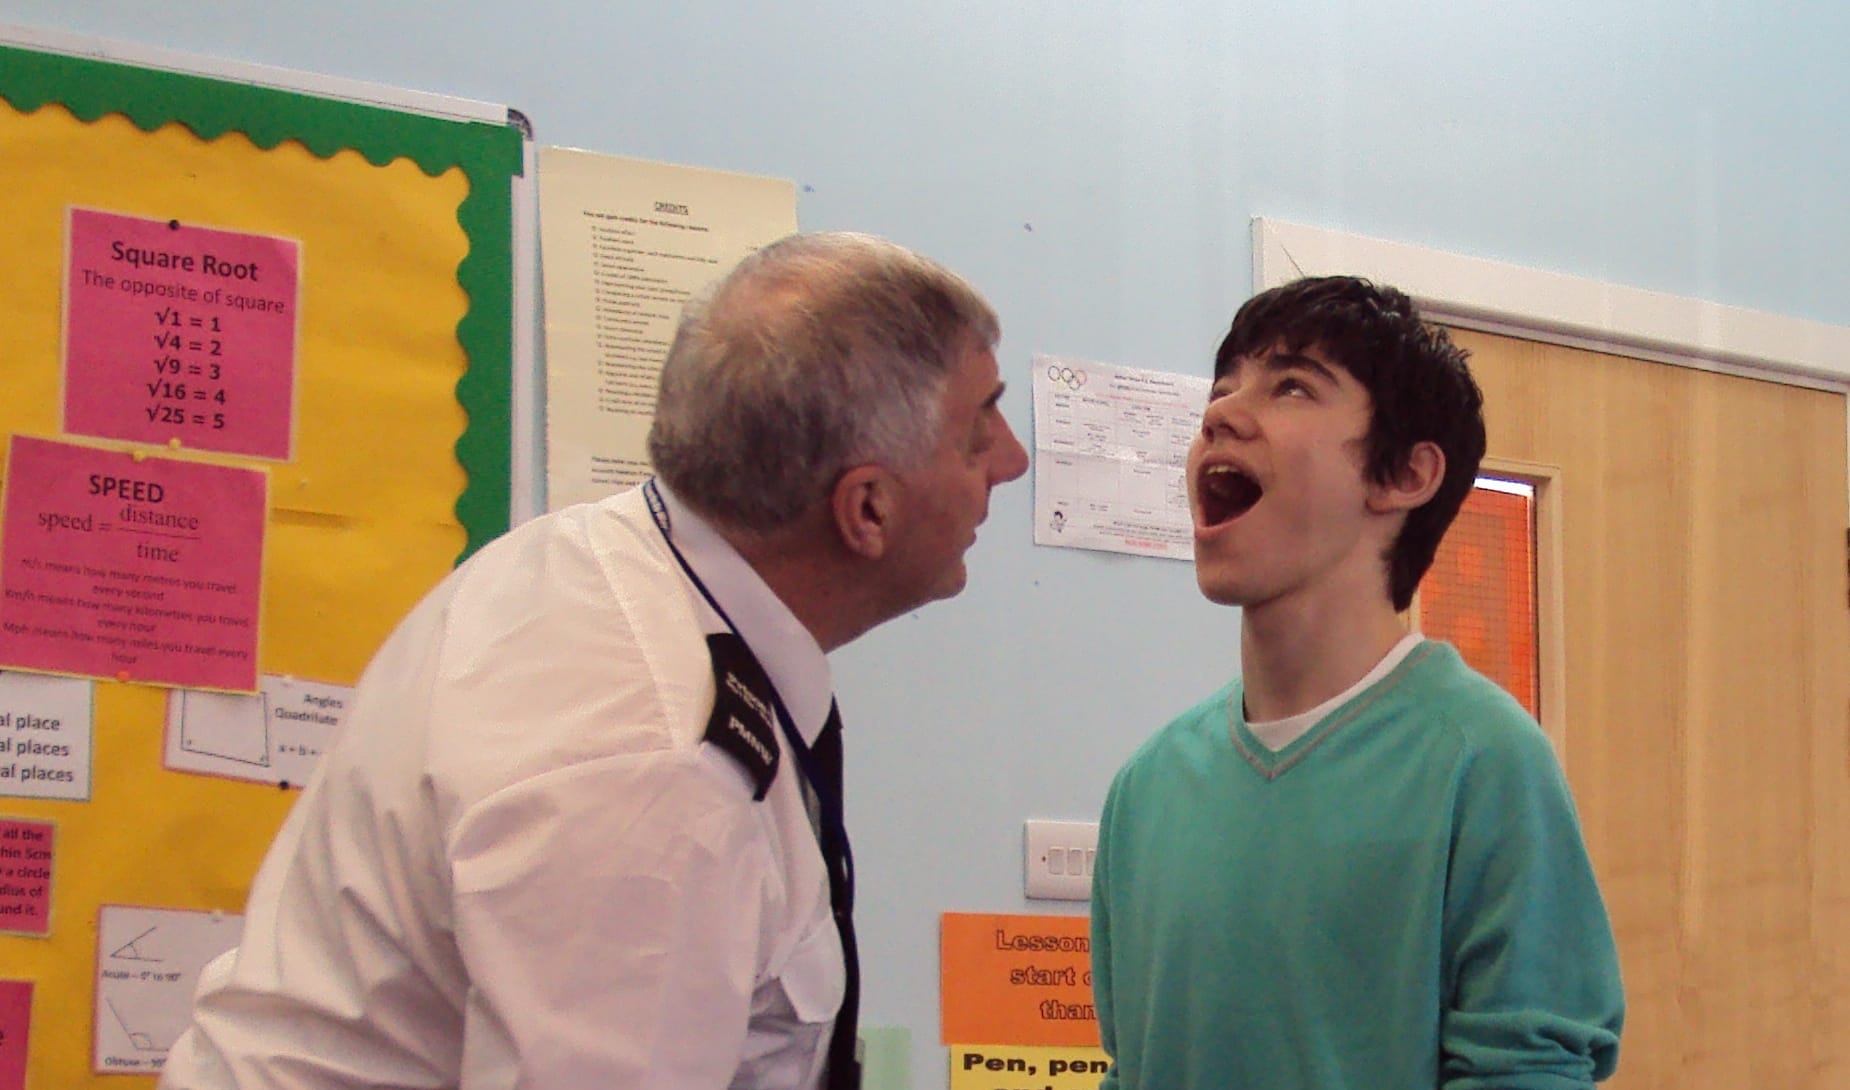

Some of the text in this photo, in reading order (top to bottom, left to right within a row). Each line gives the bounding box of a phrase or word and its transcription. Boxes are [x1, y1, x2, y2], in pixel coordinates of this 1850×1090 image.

[112, 241, 258, 281] Square Root
[82, 269, 285, 313] The opposite of square
[190, 317, 202, 327] =
[211, 317, 221, 332] 1
[189, 341, 202, 351] =
[210, 340, 222, 355] 2
[189, 365, 200, 375] =
[209, 364, 220, 379] 3
[194, 391, 206, 400] =
[214, 389, 226, 405] 4
[192, 415, 204, 424] =
[213, 413, 225, 429] 5
[89, 474, 164, 503] SPEED
[38, 510, 111, 532] speed =
[119, 504, 199, 530] distance
[136, 542, 180, 562] time
[45, 562, 81, 575] means
[83, 566, 106, 578] how
[109, 570, 139, 583] many
[182, 580, 205, 591] you
[92, 585, 123, 597] every
[77, 599, 100, 610] how
[103, 603, 132, 615] many
[197, 614, 217, 625] you
[71, 631, 94, 641] how
[97, 635, 127, 648] many
[161, 643, 182, 655] you
[304, 693, 342, 709] Angles
[16, 714, 61, 731] place
[17, 739, 70, 757] places
[21, 765, 74, 783] places
[3, 828, 43, 841] all the
[17, 867, 50, 880] circle
[29, 886, 43, 898] of
[996, 930, 1089, 952] Lesson
[1010, 965, 1075, 986] start
[105, 1056, 140, 1067] Obtuse
[963, 1054, 1108, 1077] Pen, pen
